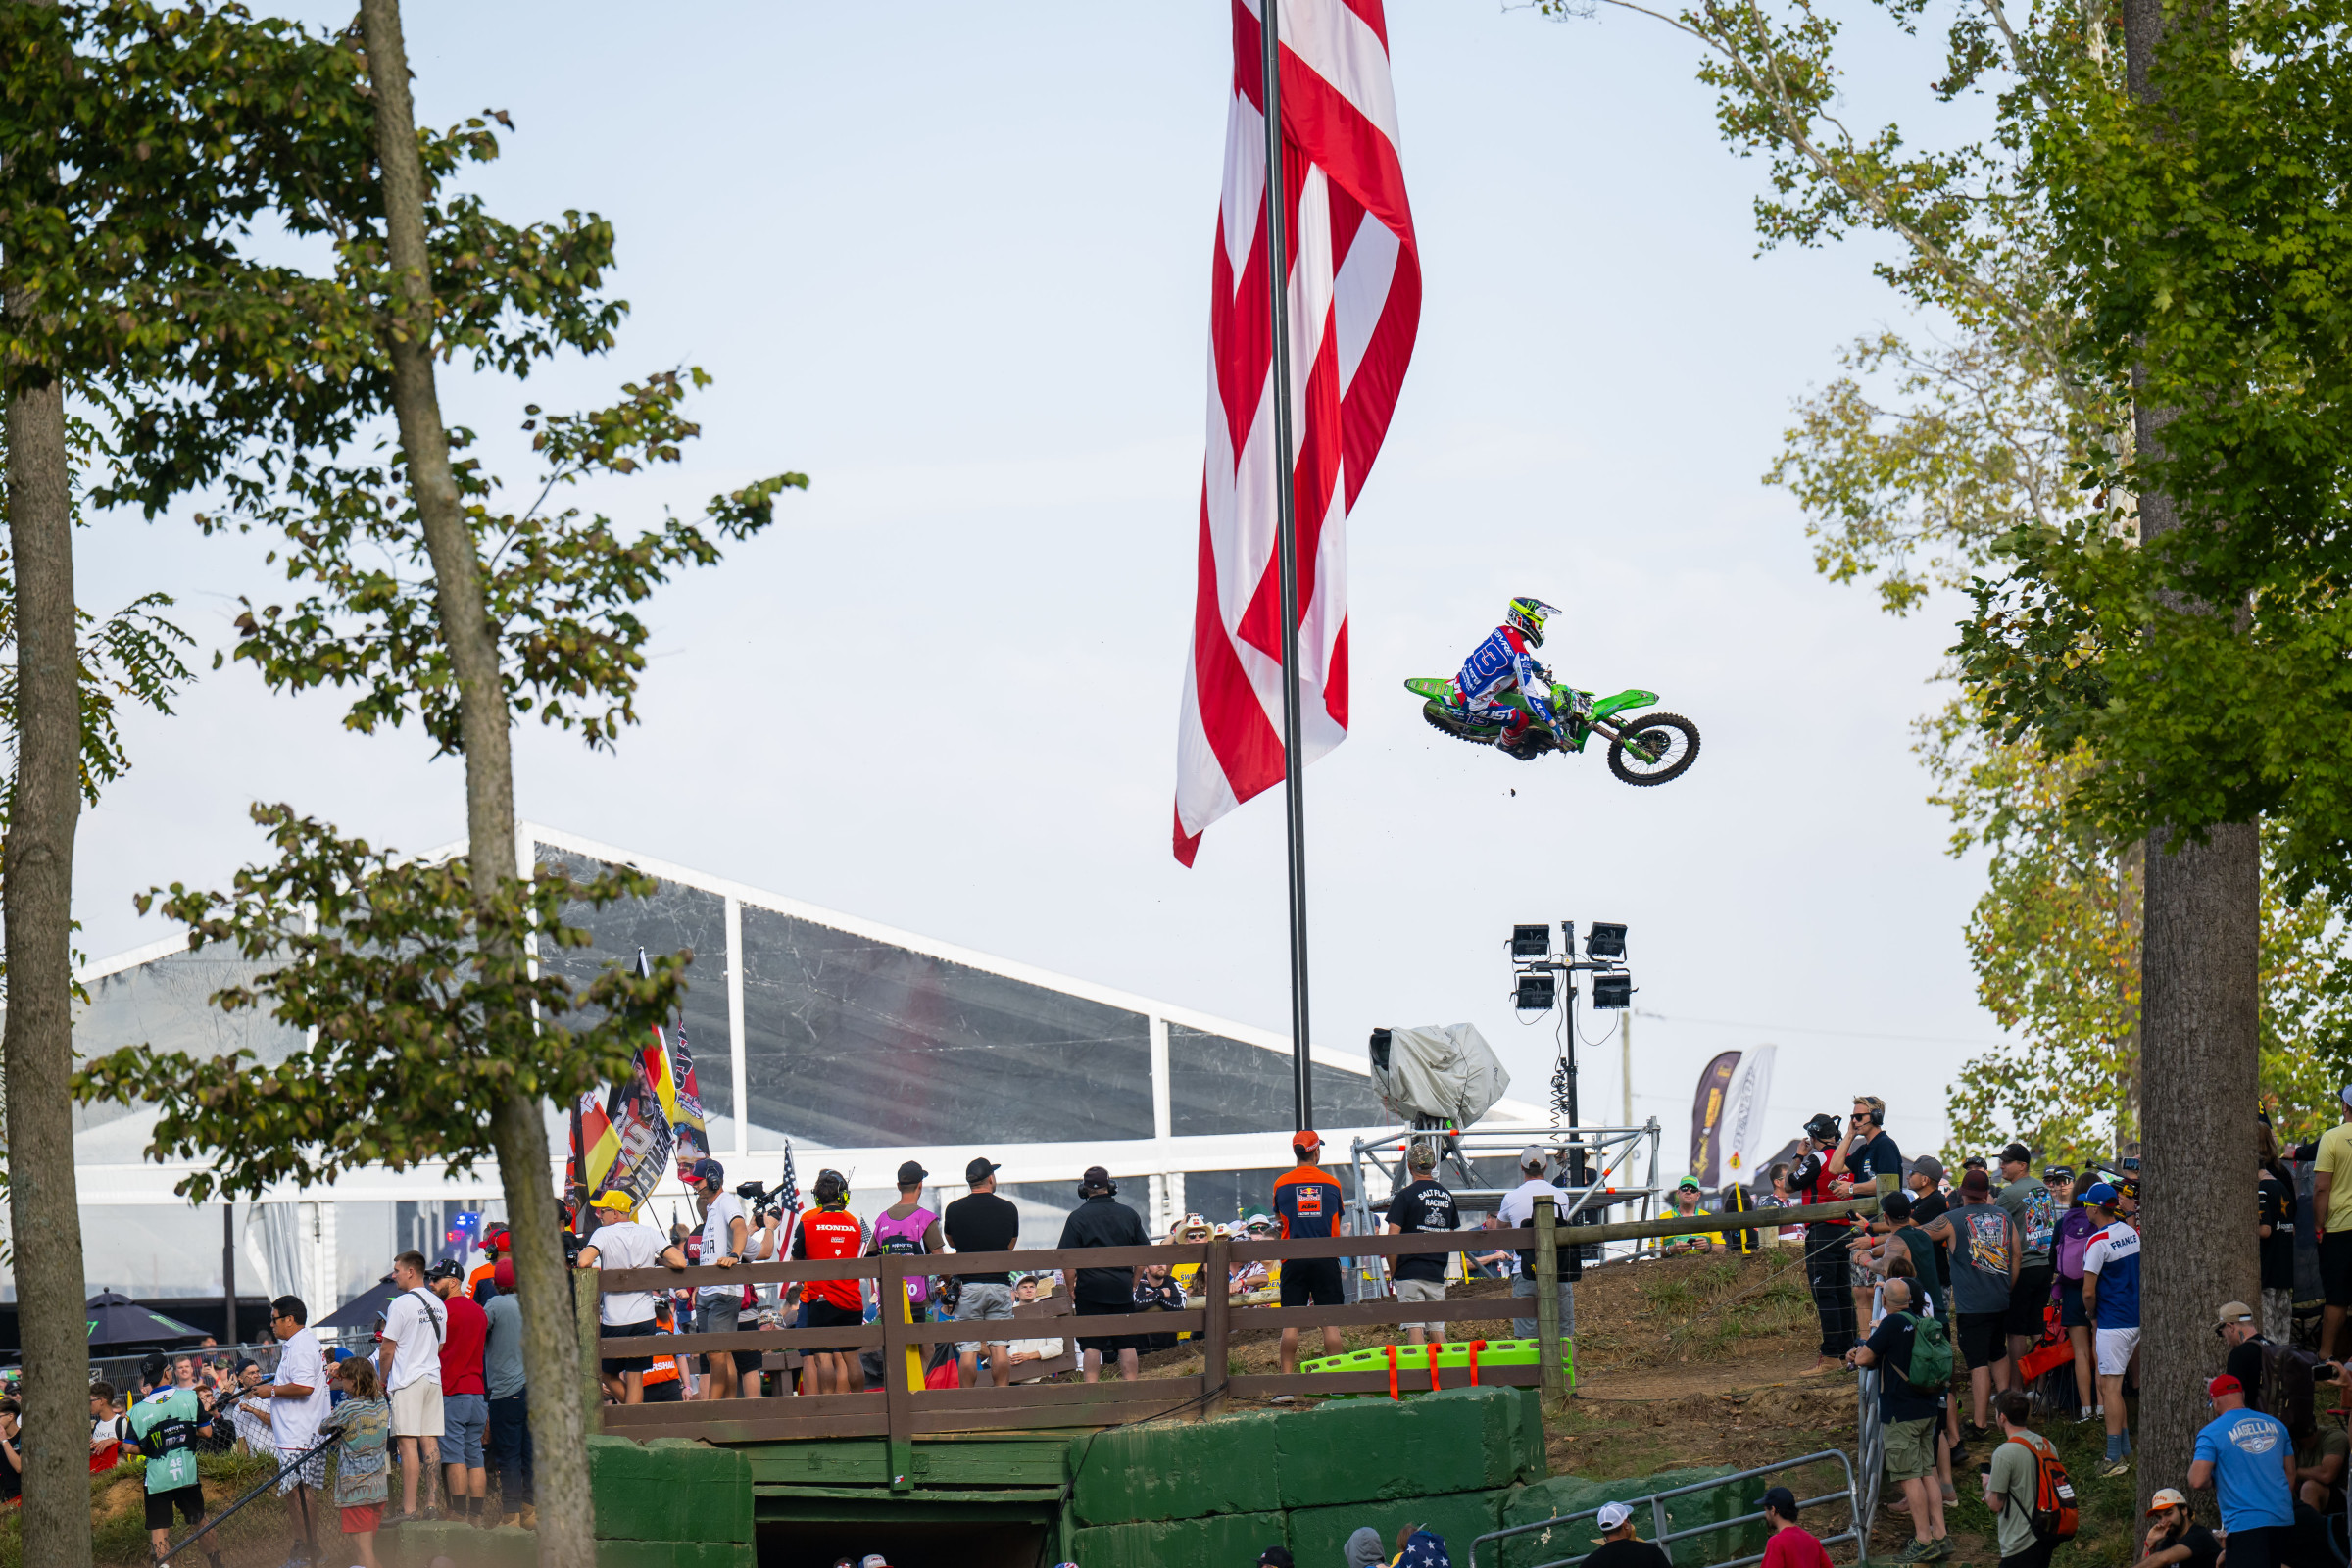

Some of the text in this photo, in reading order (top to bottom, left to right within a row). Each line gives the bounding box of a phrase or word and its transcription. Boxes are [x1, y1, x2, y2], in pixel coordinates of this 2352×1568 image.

[1418, 1189, 1452, 1203] SALT FLATS
[1425, 1199, 1449, 1208] RACING
[815, 1224, 857, 1233] HONDA
[2110, 1234, 2137, 1250] FRANCE
[2228, 1421, 2279, 1445] MAGELLAN
[170, 1457, 183, 1468] 48
[170, 1468, 184, 1482] TV
